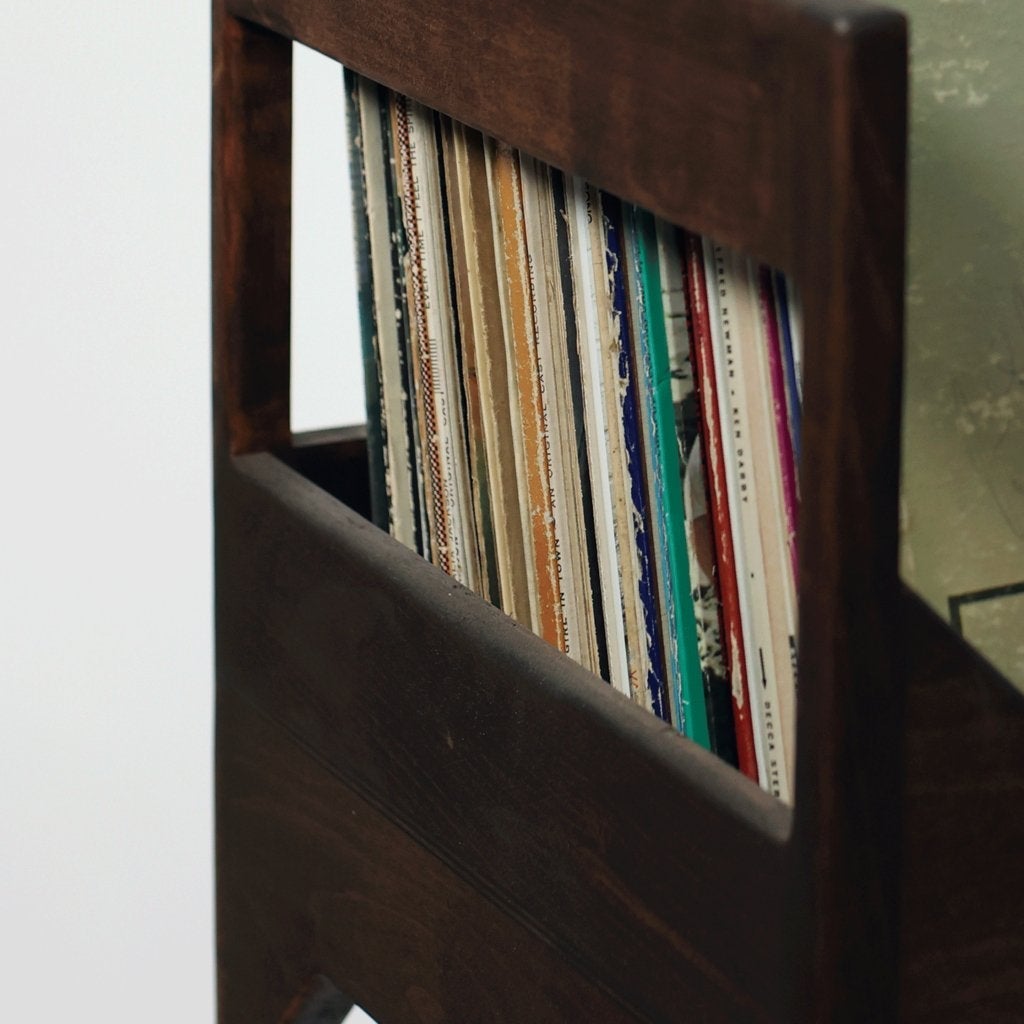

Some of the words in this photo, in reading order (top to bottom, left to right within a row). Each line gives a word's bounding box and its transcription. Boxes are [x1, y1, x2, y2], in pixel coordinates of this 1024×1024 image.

[714, 246, 727, 298] LFRED
[722, 308, 736, 379] NEWMAN
[732, 407, 742, 440] KEN
[737, 449, 749, 504] DARBY
[763, 701, 775, 751] DECCA
